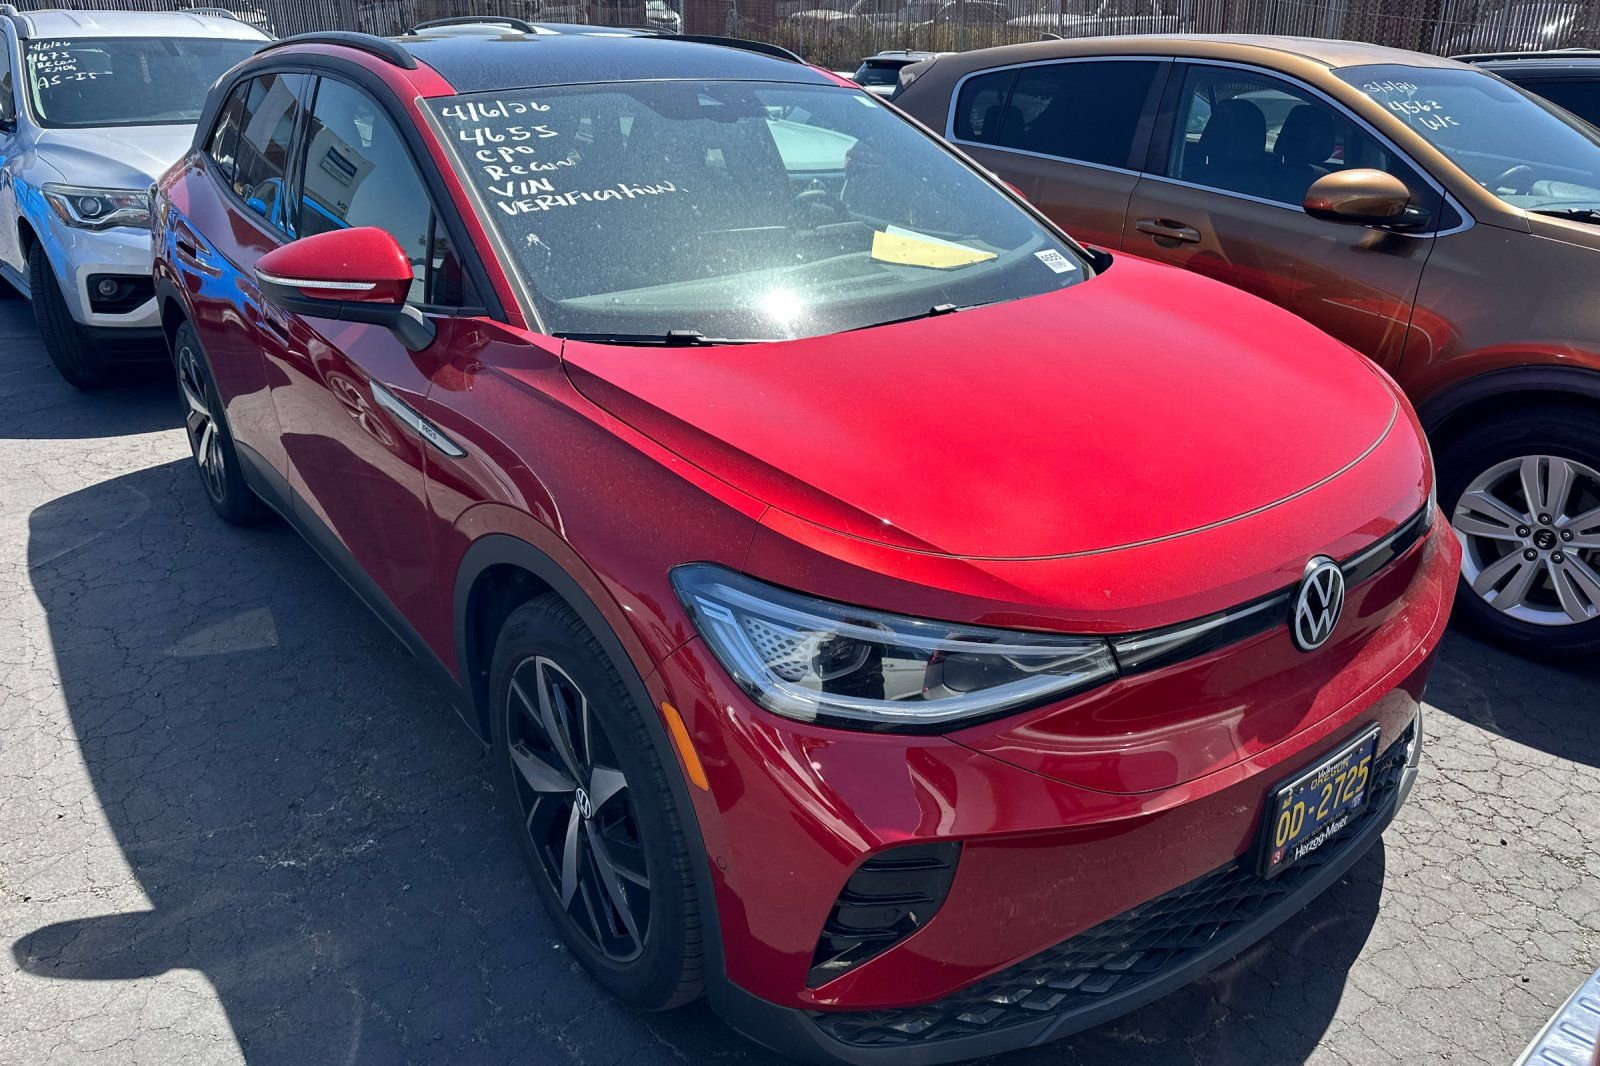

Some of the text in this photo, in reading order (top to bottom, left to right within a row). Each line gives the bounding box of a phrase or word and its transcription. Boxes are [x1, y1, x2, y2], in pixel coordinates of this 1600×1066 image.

[442, 100, 551, 122] 4/6/26
[459, 124, 559, 146] 4655
[475, 145, 535, 163] CPO
[487, 177, 554, 197] VIN
